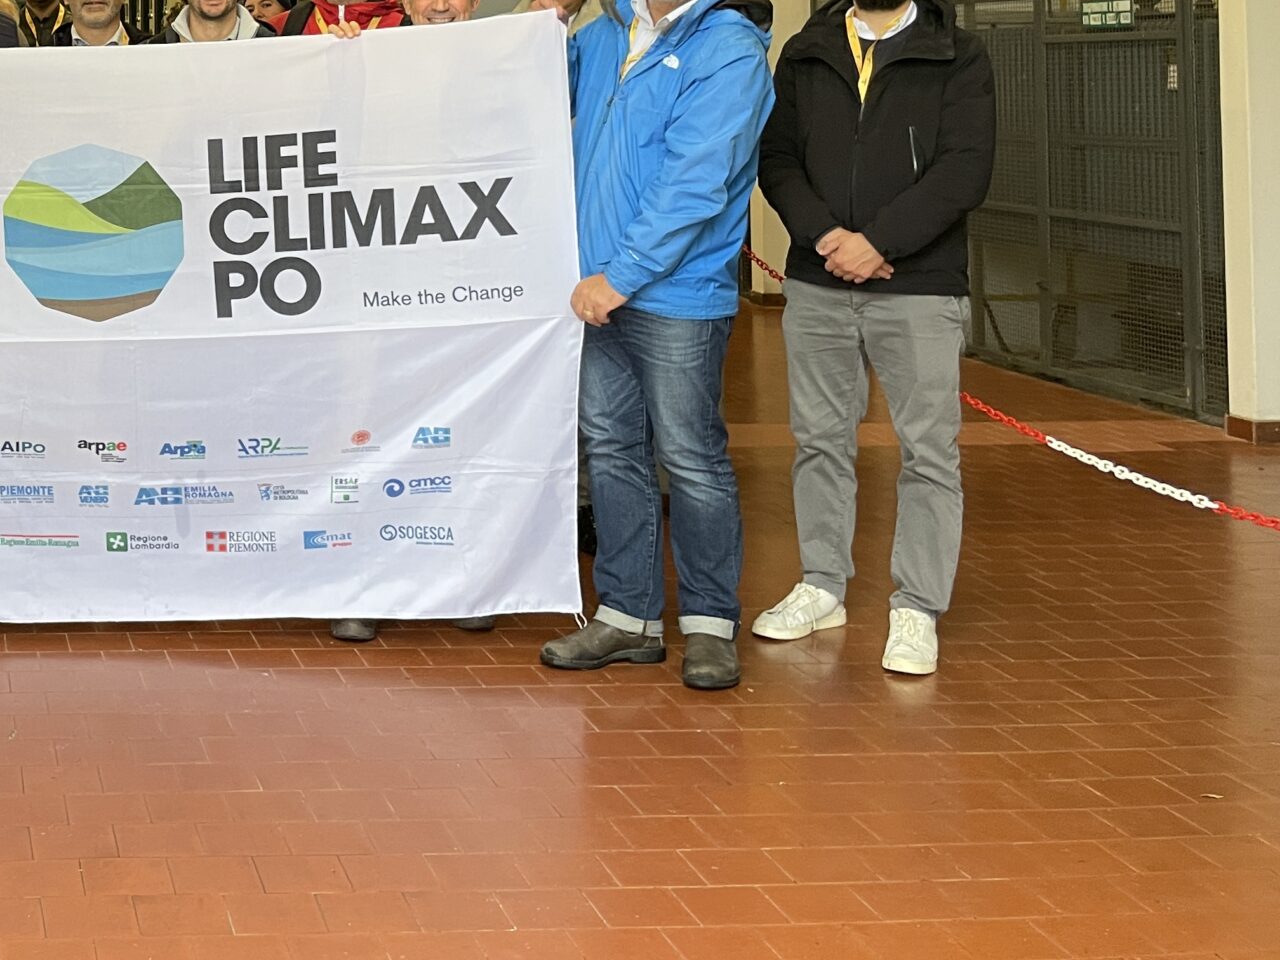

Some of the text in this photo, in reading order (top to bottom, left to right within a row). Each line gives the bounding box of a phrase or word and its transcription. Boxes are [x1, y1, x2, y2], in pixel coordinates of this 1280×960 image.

[207, 129, 338, 194] LIFE
[209, 176, 518, 255] CLIMAX
[213, 256, 322, 318] PO
[363, 283, 524, 308] Make the Change
[78, 440, 128, 455] arpae
[409, 476, 452, 488] cmcc
[0, 486, 54, 496] PIEMONTE
[130, 535, 168, 543] Regione
[229, 531, 276, 542] REGIONE
[399, 526, 454, 540] SOGESCA
[130, 542, 179, 550] Lombardia
[229, 543, 277, 552] PIEMONTE
